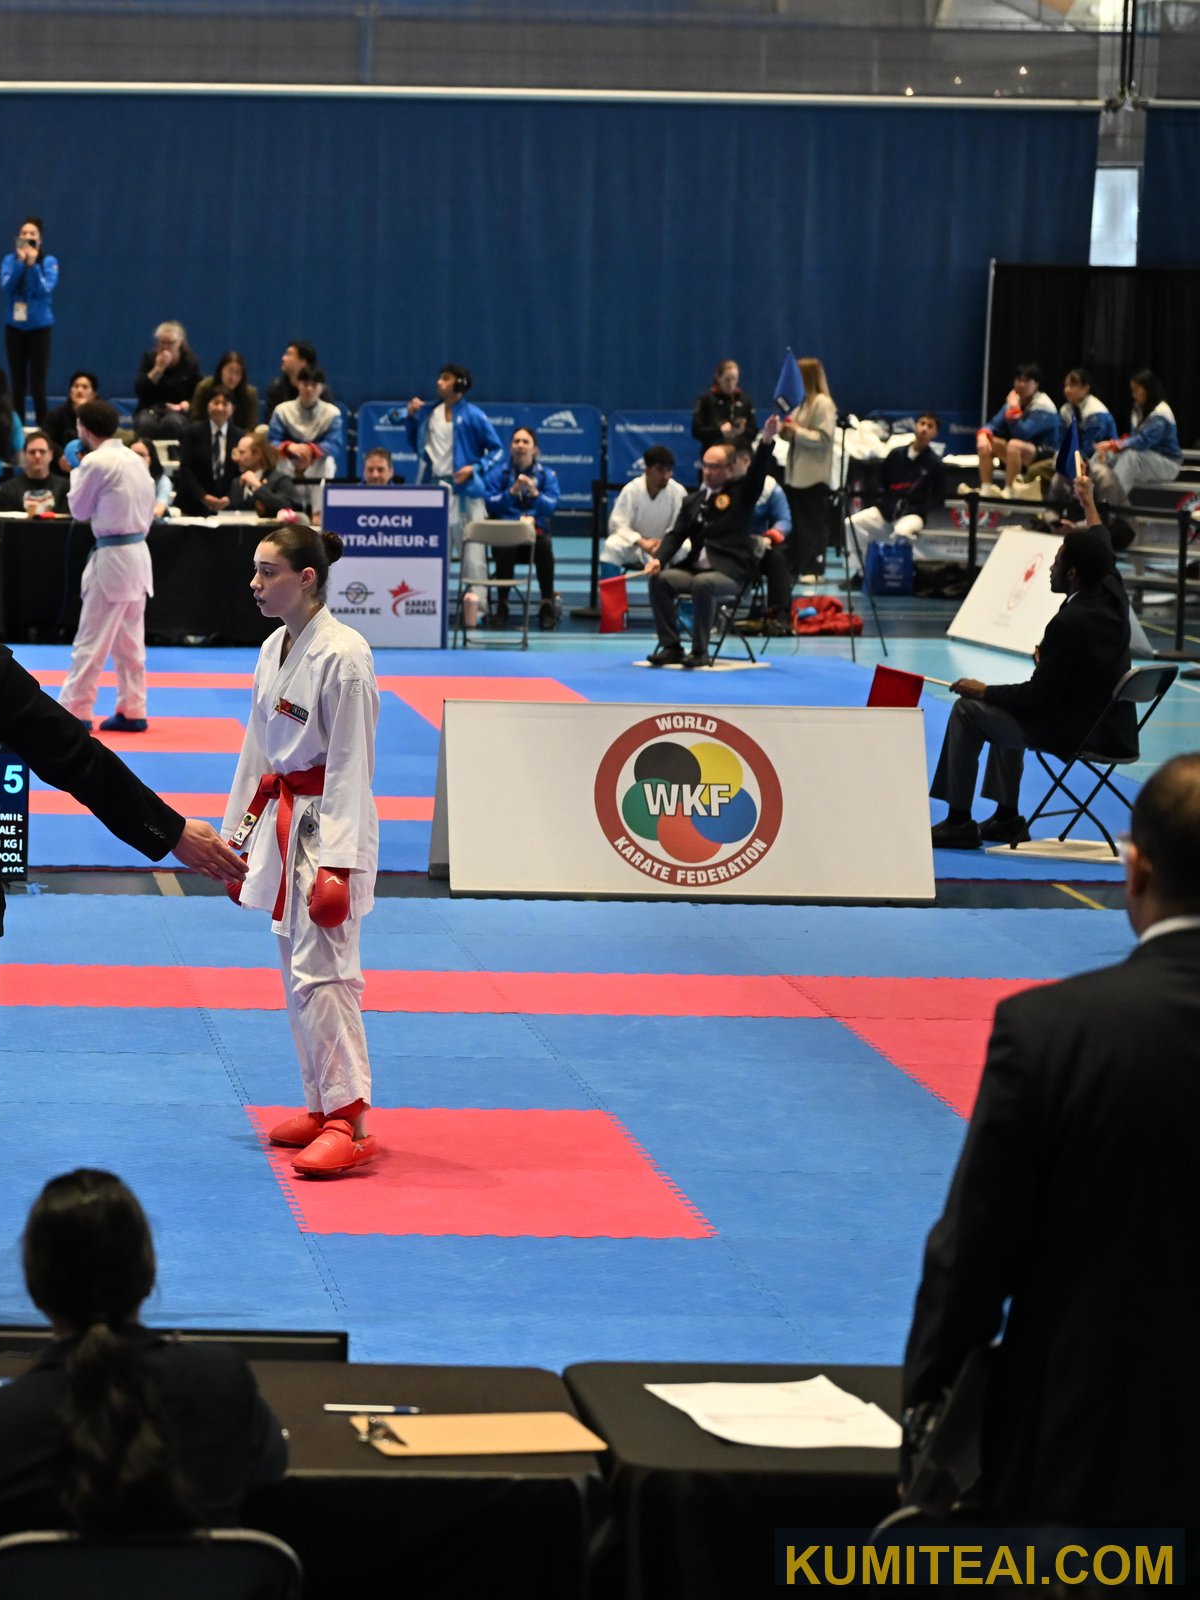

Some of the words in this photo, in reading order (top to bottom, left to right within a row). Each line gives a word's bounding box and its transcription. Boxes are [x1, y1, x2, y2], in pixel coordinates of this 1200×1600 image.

[357, 515, 412, 527] COACH
[655, 715, 718, 733] WORLD
[3, 764, 23, 794] 5
[643, 783, 731, 817] WKF
[3, 839, 17, 849] KG
[614, 836, 671, 881] KARATE
[676, 838, 767, 884] FEDERATION
